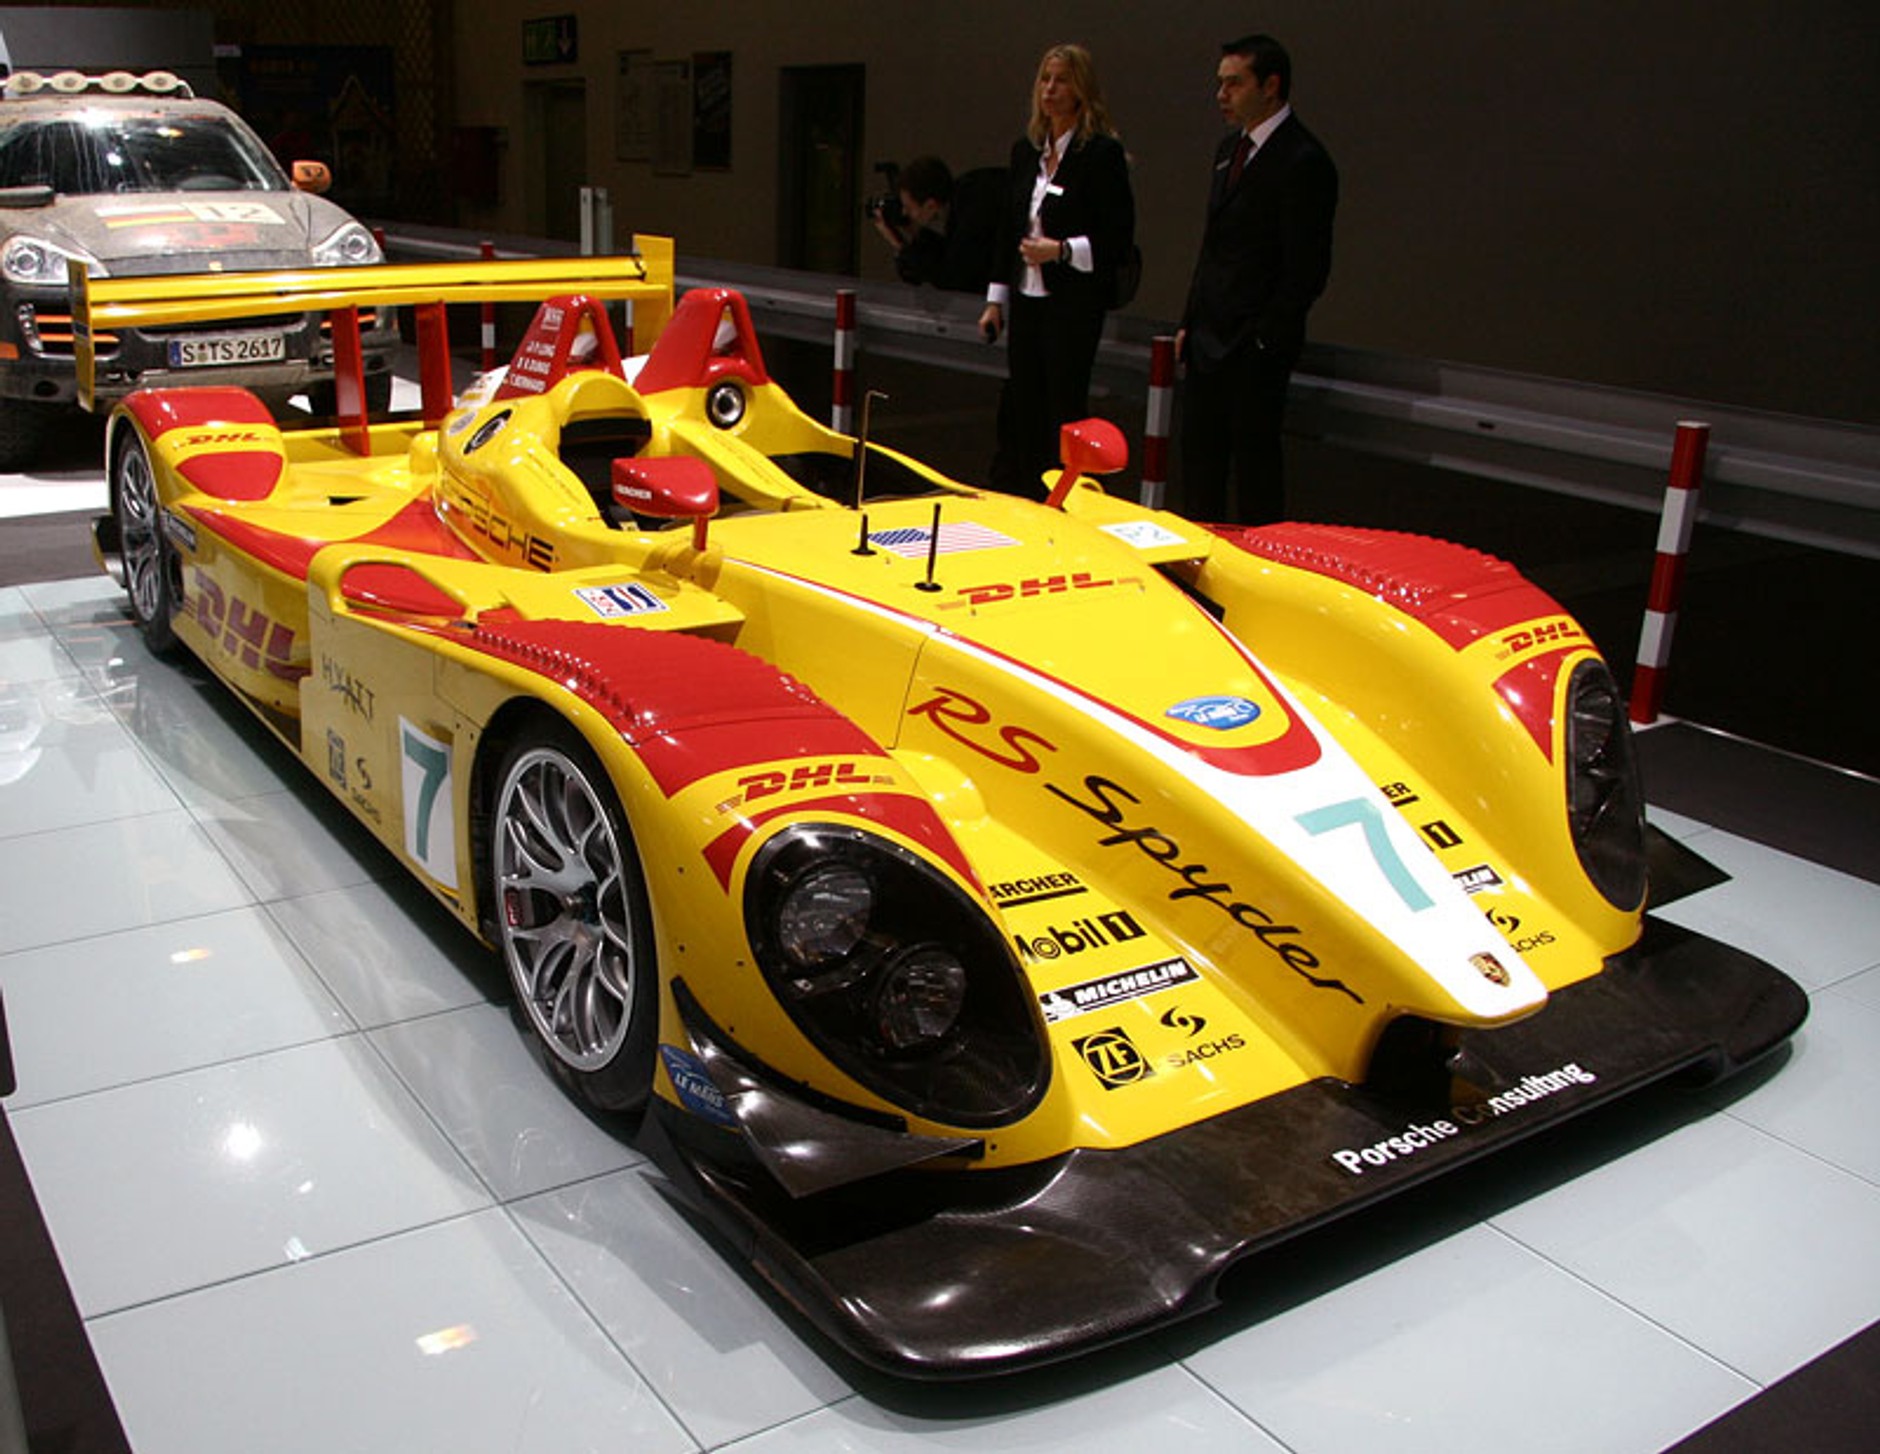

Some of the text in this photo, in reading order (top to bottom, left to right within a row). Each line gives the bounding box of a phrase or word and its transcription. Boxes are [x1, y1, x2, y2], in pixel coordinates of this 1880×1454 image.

[208, 341, 234, 361] TS
[237, 338, 281, 359] 2617
[187, 433, 261, 445] DHL
[957, 573, 1114, 605] DHL
[195, 566, 312, 684] DHL
[1502, 622, 1580, 653] DHL
[908, 686, 1058, 775] RS
[404, 729, 448, 863] 7
[738, 763, 871, 801] DHL
[1292, 796, 1436, 913] 7
[1044, 775, 1365, 1006] Spyder
[1075, 960, 1188, 1006] MICHELIN
[1167, 1034, 1248, 1067] SACHS
[1332, 1119, 1459, 1175] Porsche
